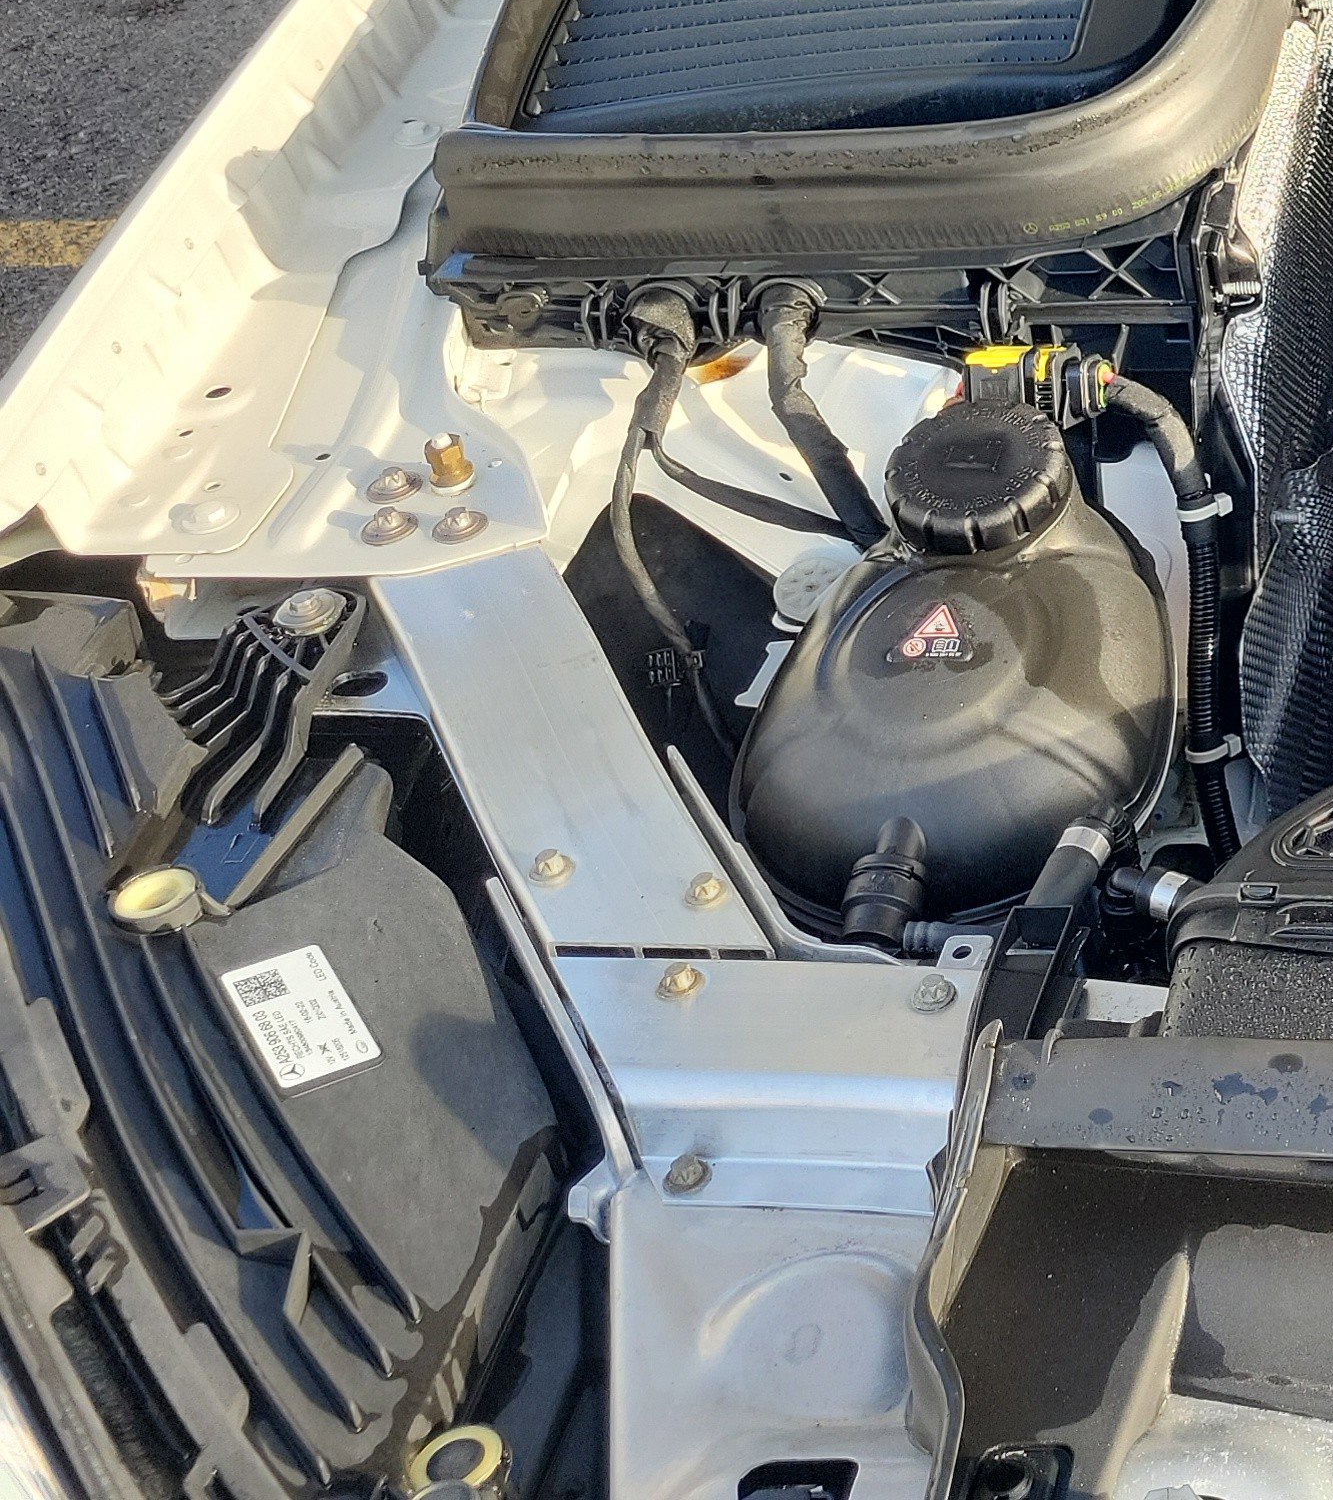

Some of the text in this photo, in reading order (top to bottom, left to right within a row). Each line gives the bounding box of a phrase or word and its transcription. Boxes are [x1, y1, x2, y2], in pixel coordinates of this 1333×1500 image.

[305, 952, 327, 982] LED Code
[328, 989, 343, 1010] Austria
[252, 1009, 268, 1022] 03
[271, 1010, 285, 1023] LED
[343, 1017, 358, 1035] Made
[263, 1029, 282, 1046] 906
[285, 1034, 305, 1059] RECHTS
[271, 1044, 292, 1065] A253
